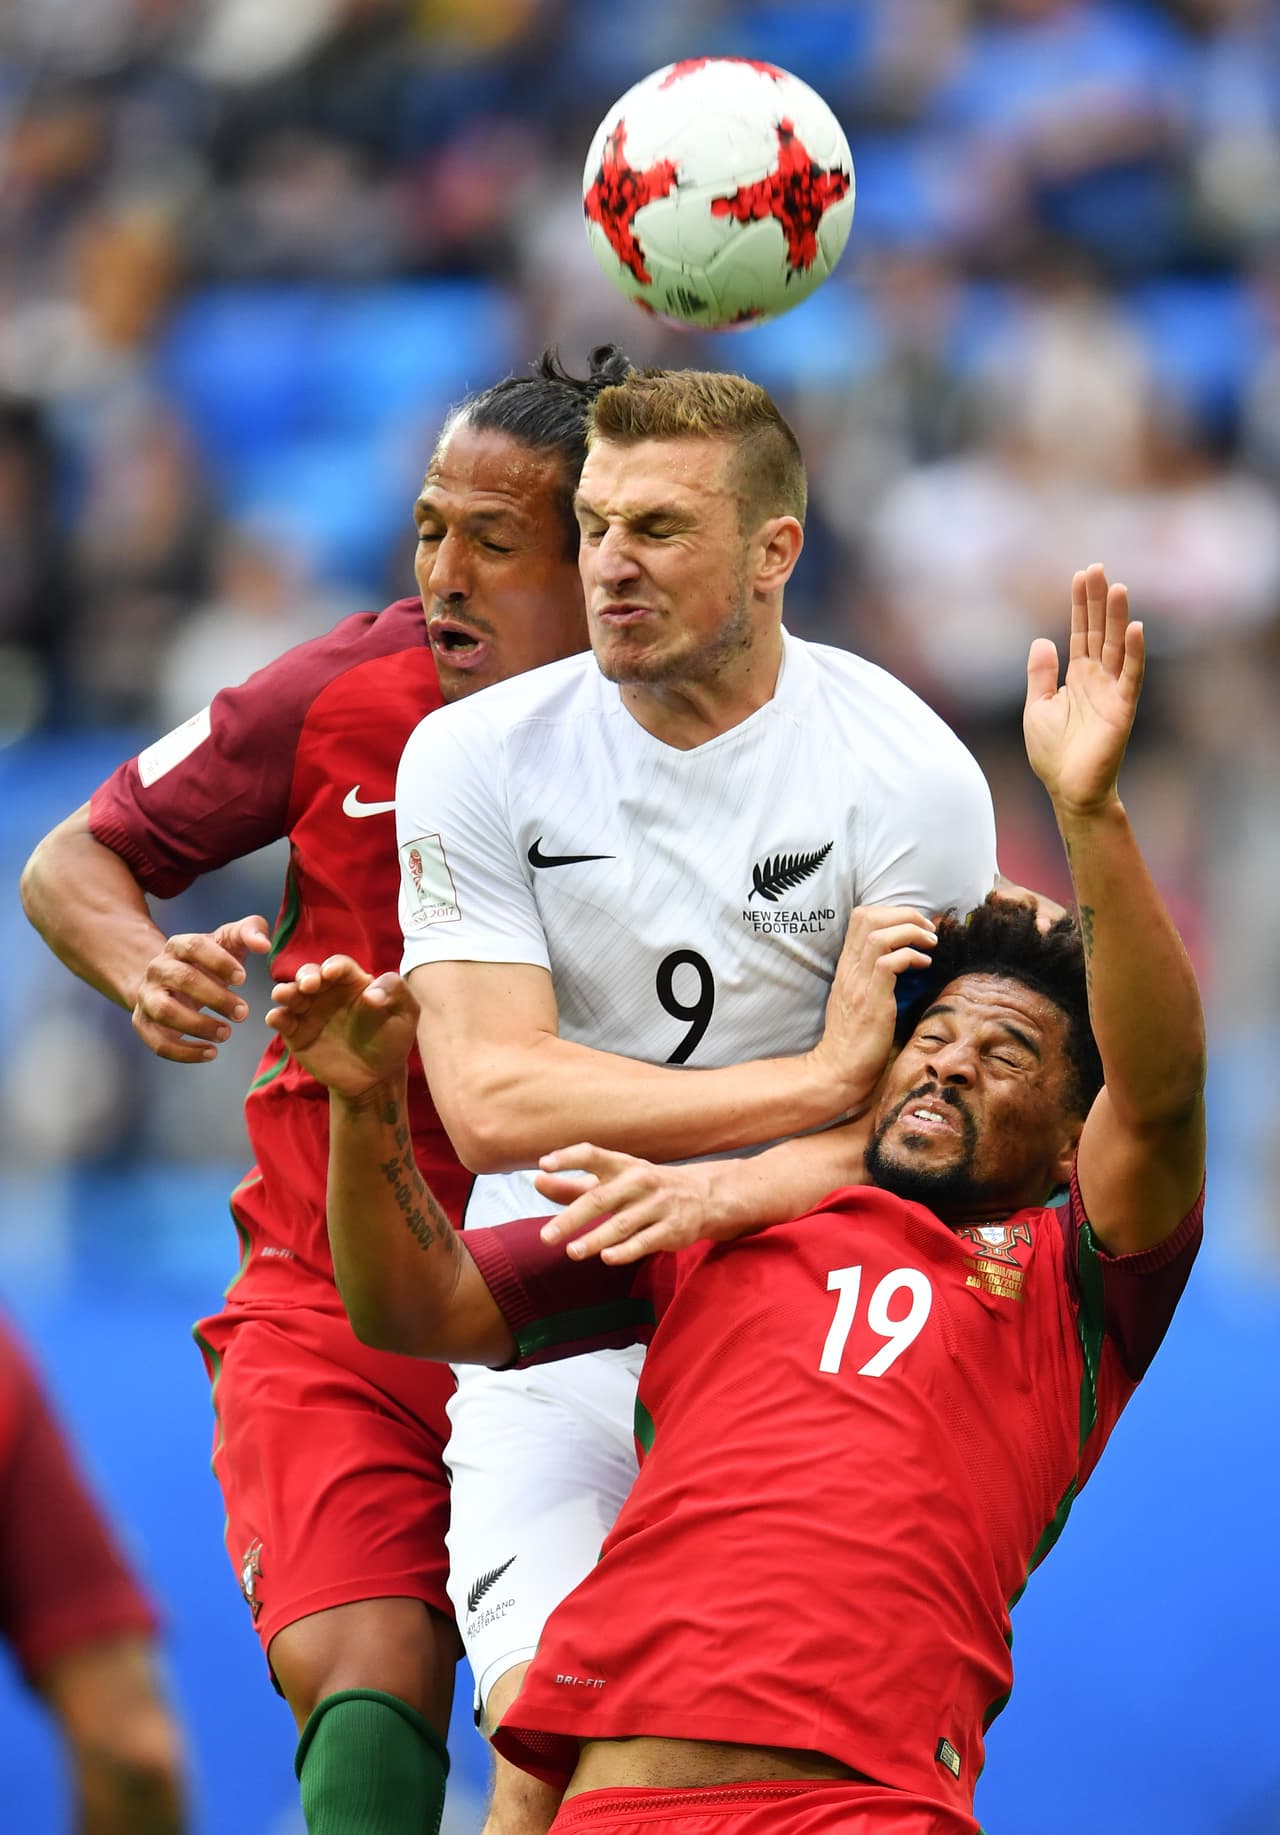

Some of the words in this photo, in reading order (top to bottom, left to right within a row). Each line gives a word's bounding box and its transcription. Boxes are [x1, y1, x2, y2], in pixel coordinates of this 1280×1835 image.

[430, 906, 455, 918] 2017
[743, 910, 772, 922] NEW
[774, 909, 836, 922] ZEALAND
[754, 922, 826, 934] FOOTBALL
[656, 949, 715, 1065] 9
[819, 1265, 933, 1378] 19
[555, 1673, 607, 1689] DRI-FIT
